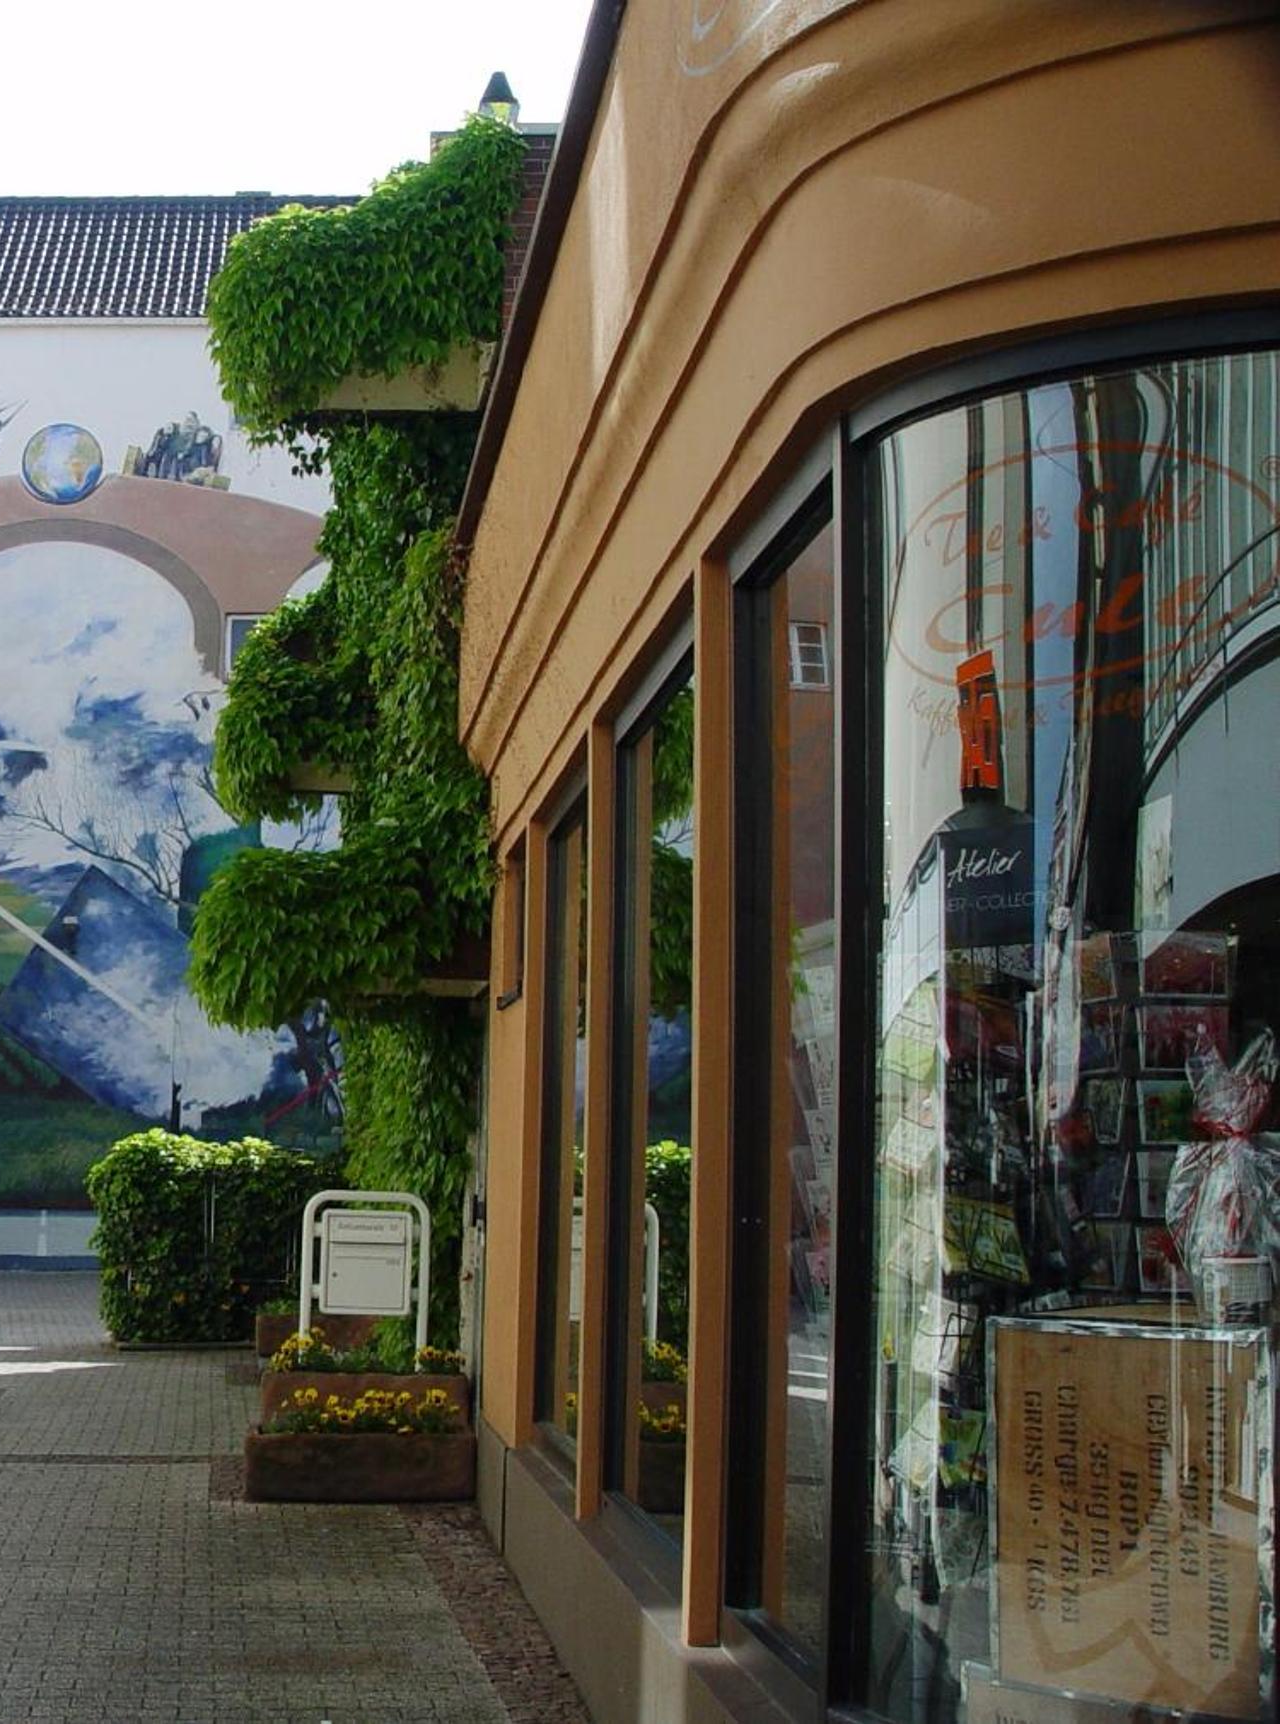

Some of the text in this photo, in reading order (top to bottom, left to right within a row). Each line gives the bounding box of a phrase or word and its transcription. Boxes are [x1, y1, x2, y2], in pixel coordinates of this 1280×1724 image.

[947, 847, 1022, 889] Atelier
[1023, 1390, 1045, 1477] GROSS
[1208, 1532, 1231, 1663] HAMBURG
